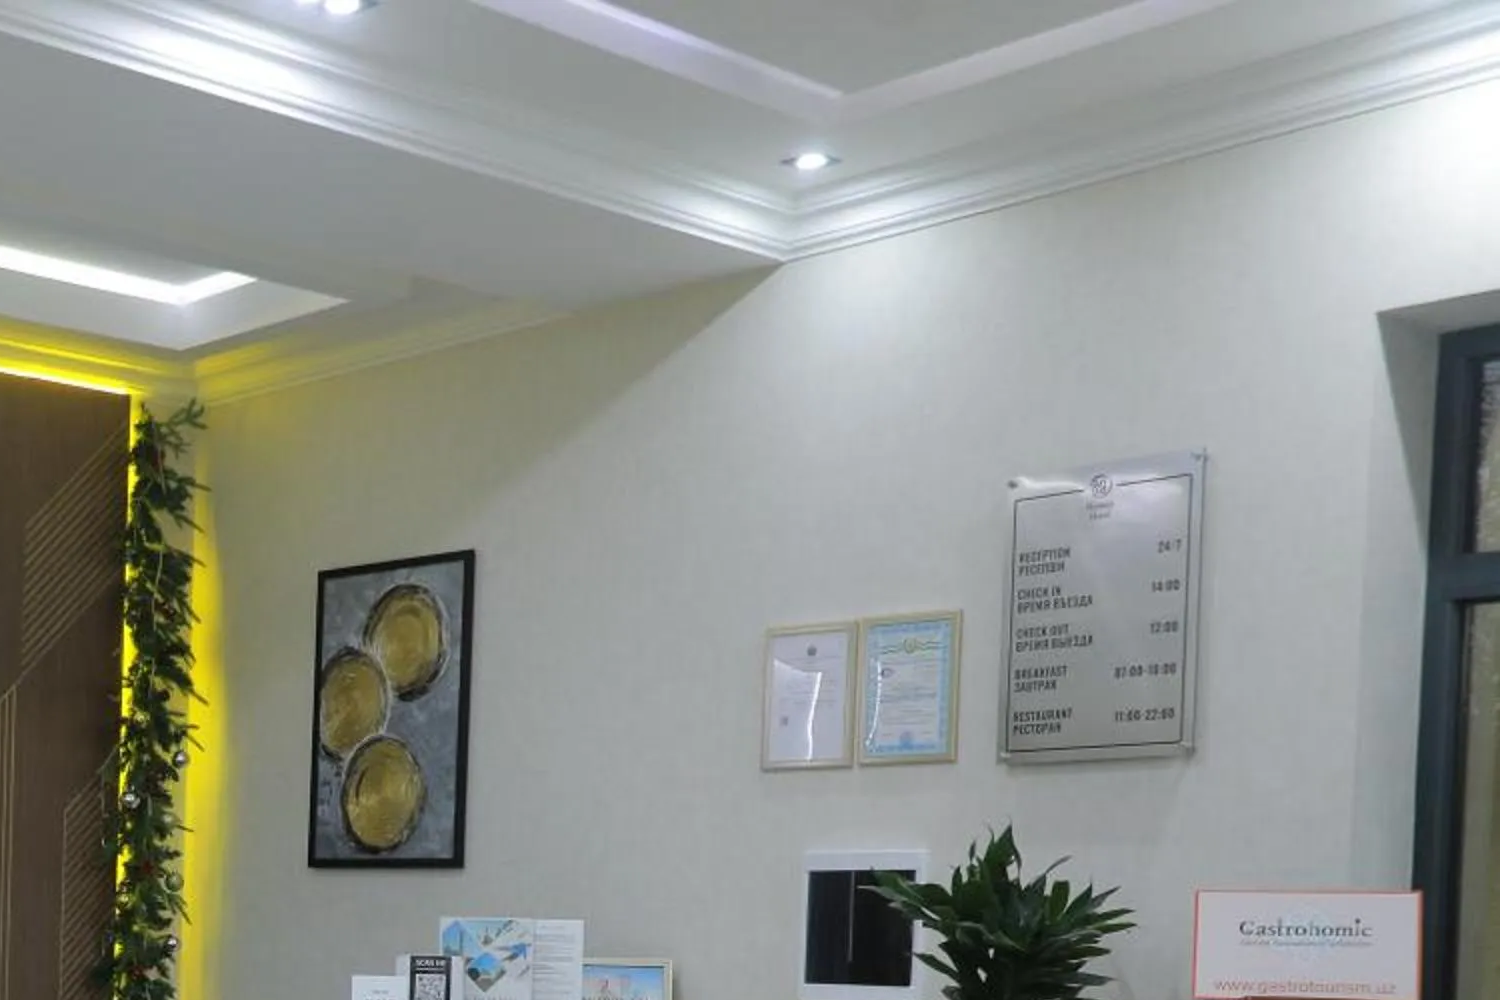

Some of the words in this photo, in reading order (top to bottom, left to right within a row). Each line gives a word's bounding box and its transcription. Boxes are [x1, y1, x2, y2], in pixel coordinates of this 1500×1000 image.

[1157, 538, 1182, 554] 24/7
[1019, 547, 1070, 563] RECEPTION
[1017, 587, 1049, 601] CHECK
[1051, 585, 1062, 597] IN
[1151, 578, 1181, 593] 14:00
[1017, 599, 1051, 614] ВРЕМЯ
[1054, 595, 1093, 609] ВЪЕЗДА
[1015, 626, 1047, 640] CHECK
[1049, 623, 1069, 636] OUT
[1150, 620, 1179, 635] 12:00
[1015, 637, 1049, 653] ВРЕМЯ
[1051, 634, 1093, 650] ВЫЕЗДА
[1013, 665, 1068, 681] BREAKFAST
[1013, 679, 1057, 694] ЗАВТРАК
[1012, 707, 1073, 723] RESTAURANT
[1012, 723, 1062, 737] РЕСТОРАН
[1215, 980, 1396, 994] www.gastrotourism.uz
